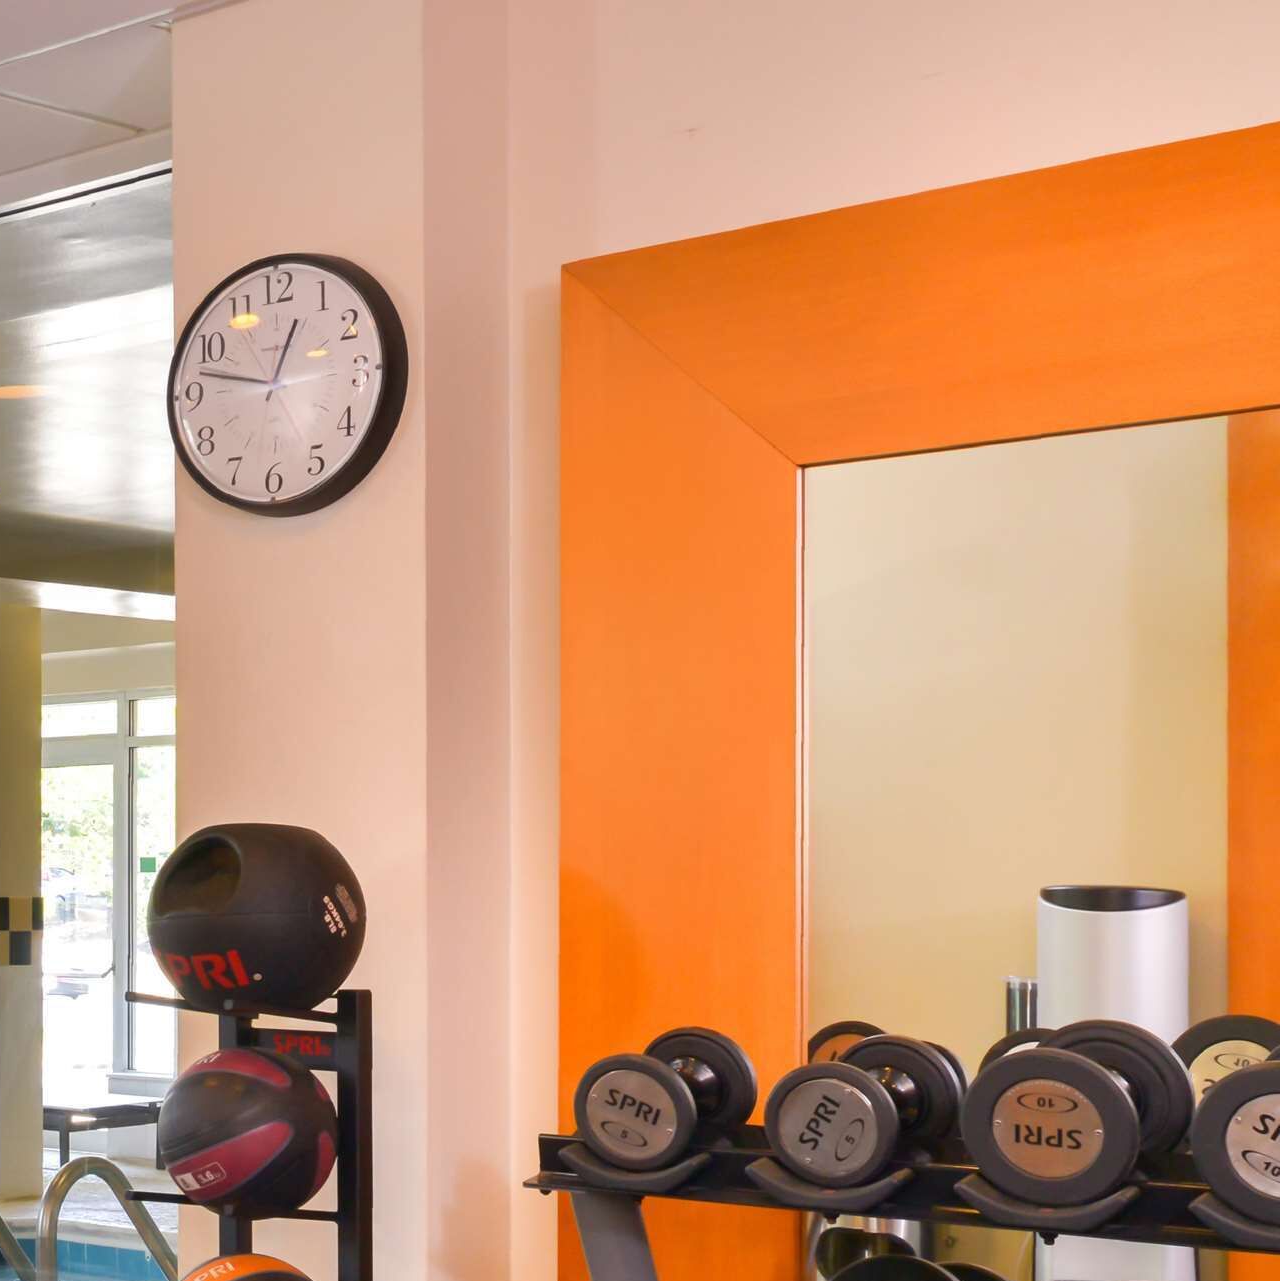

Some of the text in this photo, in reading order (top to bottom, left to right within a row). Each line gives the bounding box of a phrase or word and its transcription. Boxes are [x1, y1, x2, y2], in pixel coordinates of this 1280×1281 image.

[261, 271, 294, 306] 12
[316, 280, 329, 312] 1
[341, 308, 358, 341] 2
[198, 331, 225, 365] 10
[352, 355, 369, 387] 3
[185, 381, 203, 412] 9
[336, 406, 356, 436] 4
[197, 426, 214, 456] 8
[226, 456, 243, 486] 7
[307, 444, 325, 476] 5
[265, 462, 283, 495] 6
[604, 1088, 662, 1127] SPRI
[1037, 1096, 1055, 1109] 10
[620, 1129, 629, 1139] 5
[798, 1094, 842, 1152] SPRI
[1013, 1123, 1083, 1150] SPRI
[846, 1134, 855, 1146] 5
